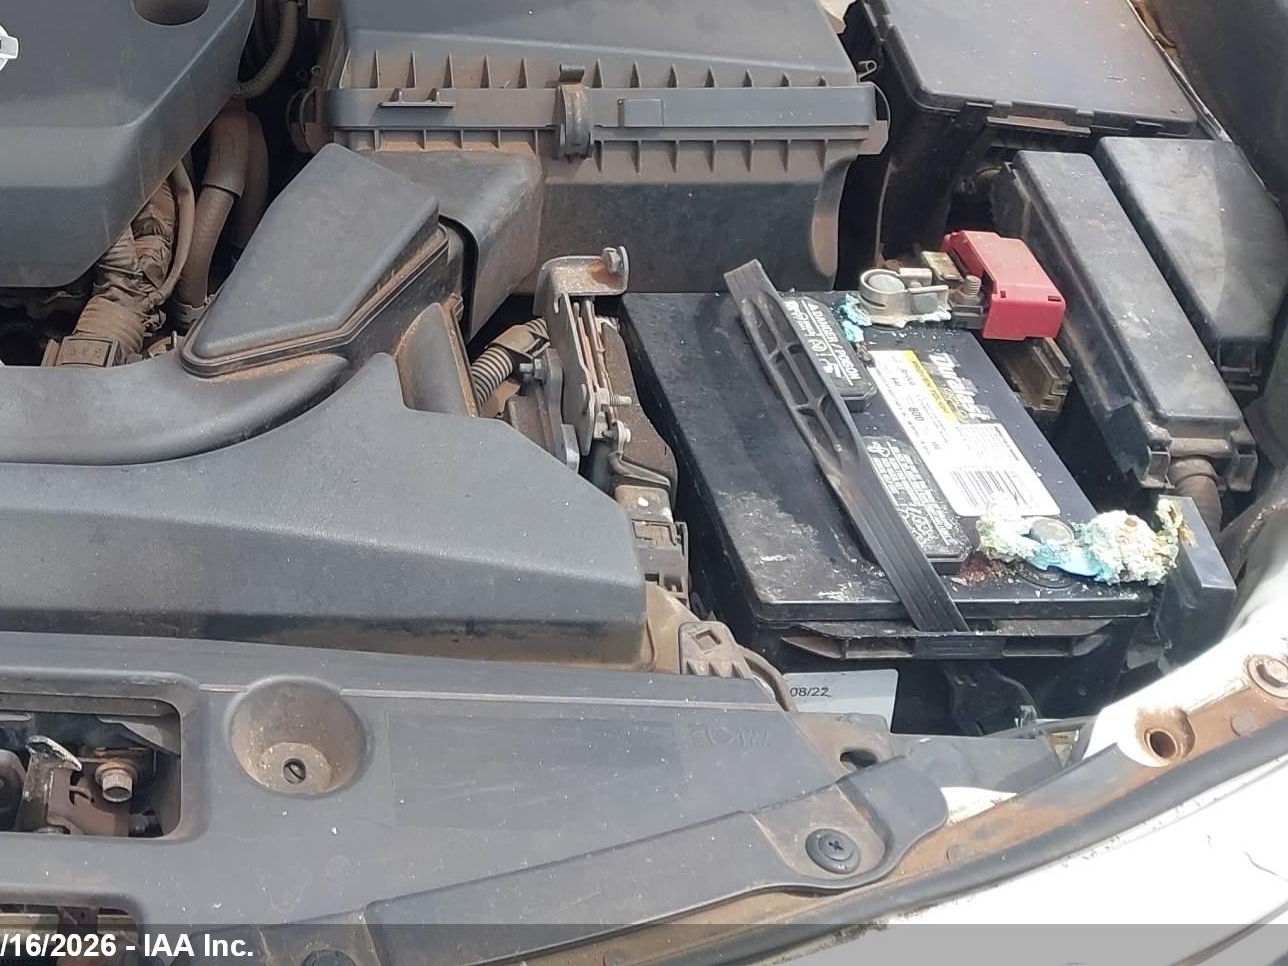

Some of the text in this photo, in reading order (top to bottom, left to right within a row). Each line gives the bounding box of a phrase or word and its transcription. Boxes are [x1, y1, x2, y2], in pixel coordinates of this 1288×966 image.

[812, 310, 839, 343] DANGER
[834, 349, 863, 380] POISON
[908, 406, 925, 422] 800
[789, 686, 831, 698] 08/22
